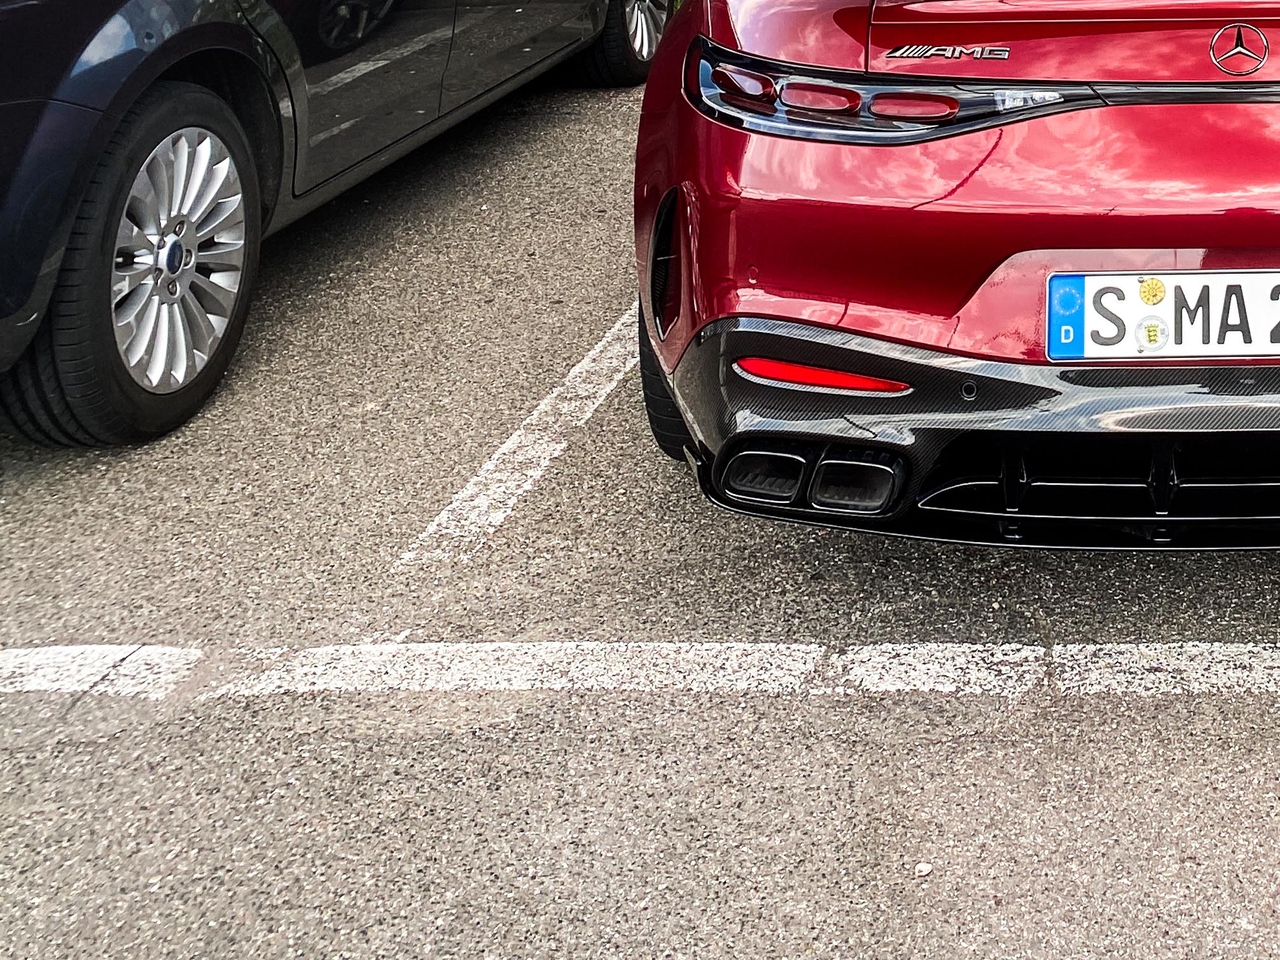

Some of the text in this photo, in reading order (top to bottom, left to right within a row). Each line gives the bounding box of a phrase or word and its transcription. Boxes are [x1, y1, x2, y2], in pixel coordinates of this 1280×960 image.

[920, 45, 1011, 60] AMG
[1090, 286, 1126, 346] S
[1174, 284, 1253, 345] MA
[1061, 325, 1074, 343] D
